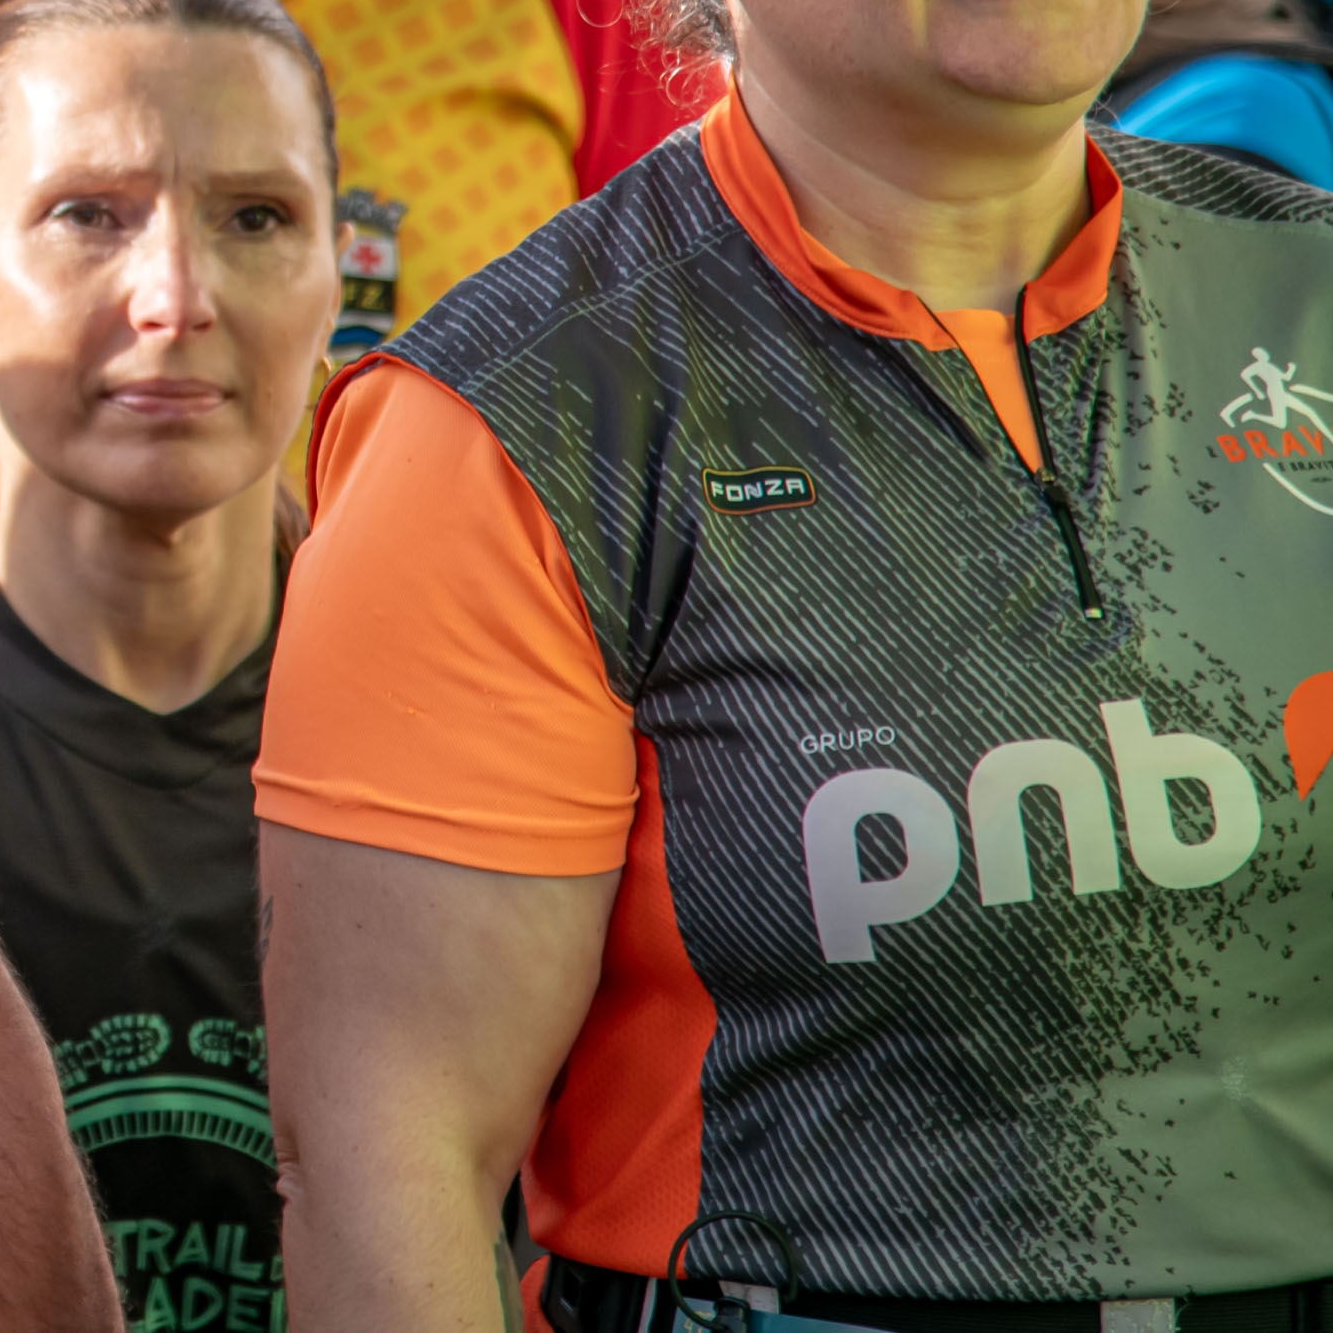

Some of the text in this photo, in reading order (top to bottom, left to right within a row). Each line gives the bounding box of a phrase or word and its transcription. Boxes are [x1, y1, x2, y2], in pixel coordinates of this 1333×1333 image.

[1216, 425, 1333, 463] BRAV
[710, 477, 806, 503] FONZA
[800, 726, 896, 755] GRUPO
[802, 697, 1262, 964] pnb
[106, 1218, 265, 1282] TRAIL
